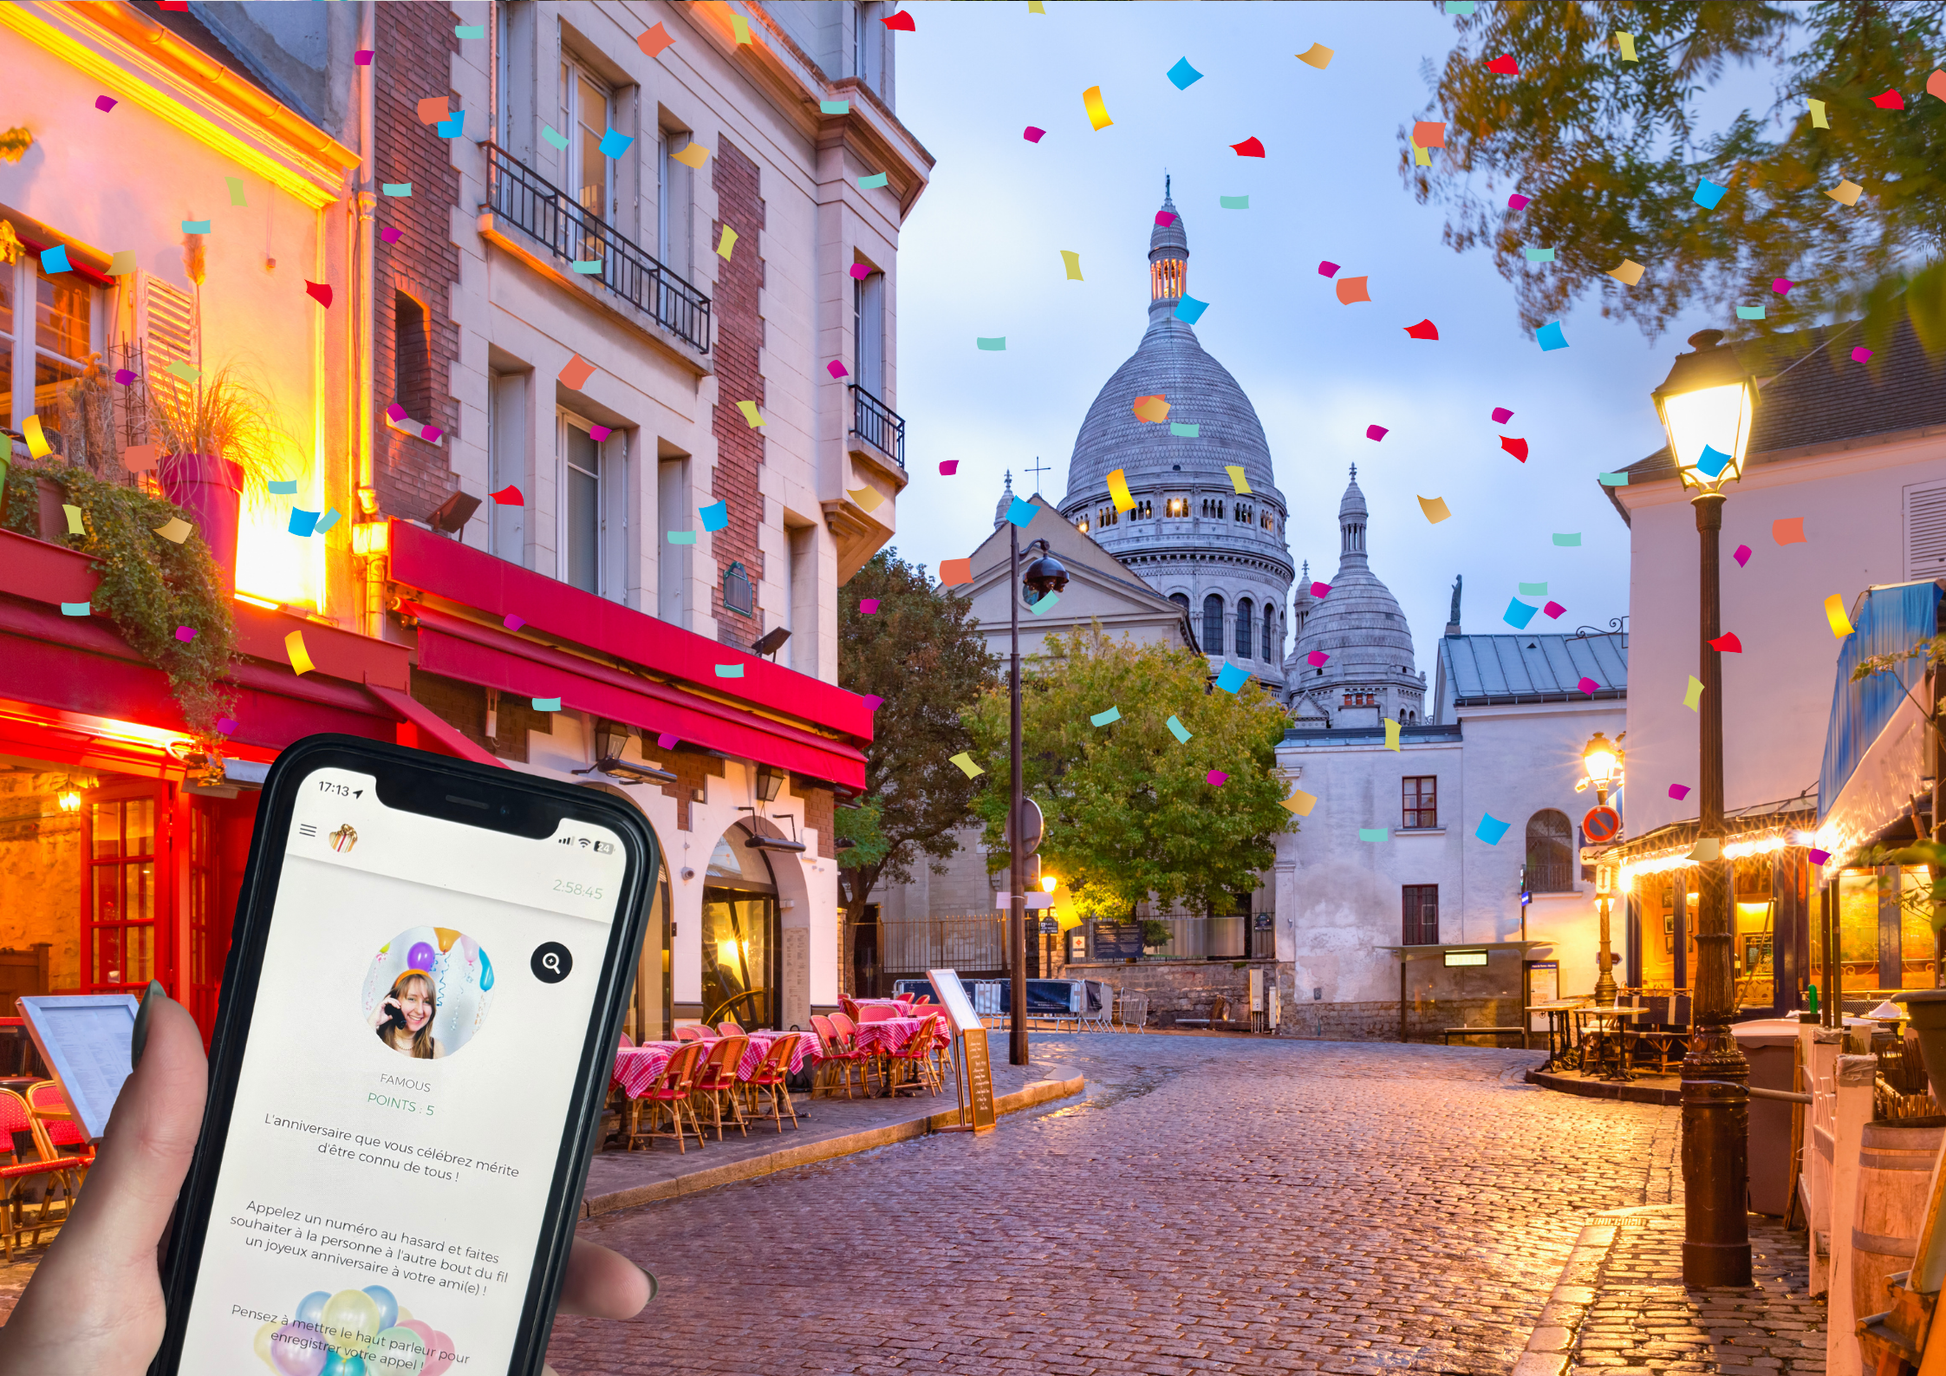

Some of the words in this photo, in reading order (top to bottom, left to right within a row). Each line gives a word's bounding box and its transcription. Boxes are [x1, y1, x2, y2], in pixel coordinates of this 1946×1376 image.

[318, 780, 350, 798] 17:13
[596, 843, 610, 853] 24
[553, 879, 603, 900] 2:58:45
[380, 1073, 431, 1092] FAMOUS
[367, 1092, 416, 1112] POINTS
[426, 1105, 434, 1116] 5
[265, 1113, 351, 1140] L'anniversaire
[355, 1135, 381, 1147] que
[385, 1141, 413, 1154] vous
[417, 1148, 472, 1167] célébrez
[476, 1161, 519, 1177] mérite
[318, 1143, 355, 1159] d'être
[359, 1153, 400, 1169] connu
[404, 1161, 420, 1173] de
[425, 1166, 452, 1180] tous
[230, 1217, 292, 1236] souhaiter
[295, 1227, 302, 1238] à
[307, 1230, 317, 1241] la
[321, 1236, 382, 1255] personne
[385, 1247, 393, 1258] à
[397, 1249, 436, 1267] l'autre
[441, 1259, 472, 1275] bout
[475, 1267, 492, 1280] du
[497, 1271, 508, 1282] fil
[246, 1201, 301, 1221] Appelez
[305, 1215, 321, 1225] un
[325, 1219, 377, 1237] numéro
[381, 1231, 397, 1241] au
[401, 1232, 445, 1251] hasard
[448, 1246, 462, 1255] et
[466, 1247, 499, 1263] faites
[246, 1237, 262, 1248] un
[264, 1239, 308, 1257] joyeux
[311, 1251, 388, 1274] anniversaire
[392, 1266, 399, 1277] à
[404, 1270, 435, 1284] votre
[439, 1279, 479, 1296] ami(e)
[232, 1305, 278, 1323] Pensez
[281, 1315, 288, 1325] à
[292, 1320, 337, 1336] mettre
[341, 1327, 352, 1339] le
[356, 1330, 386, 1346] haut
[389, 1340, 436, 1357] parleur
[439, 1351, 470, 1363] pour
[271, 1332, 341, 1354] enregistrer
[345, 1348, 376, 1361] votre
[380, 1356, 417, 1370] appel
